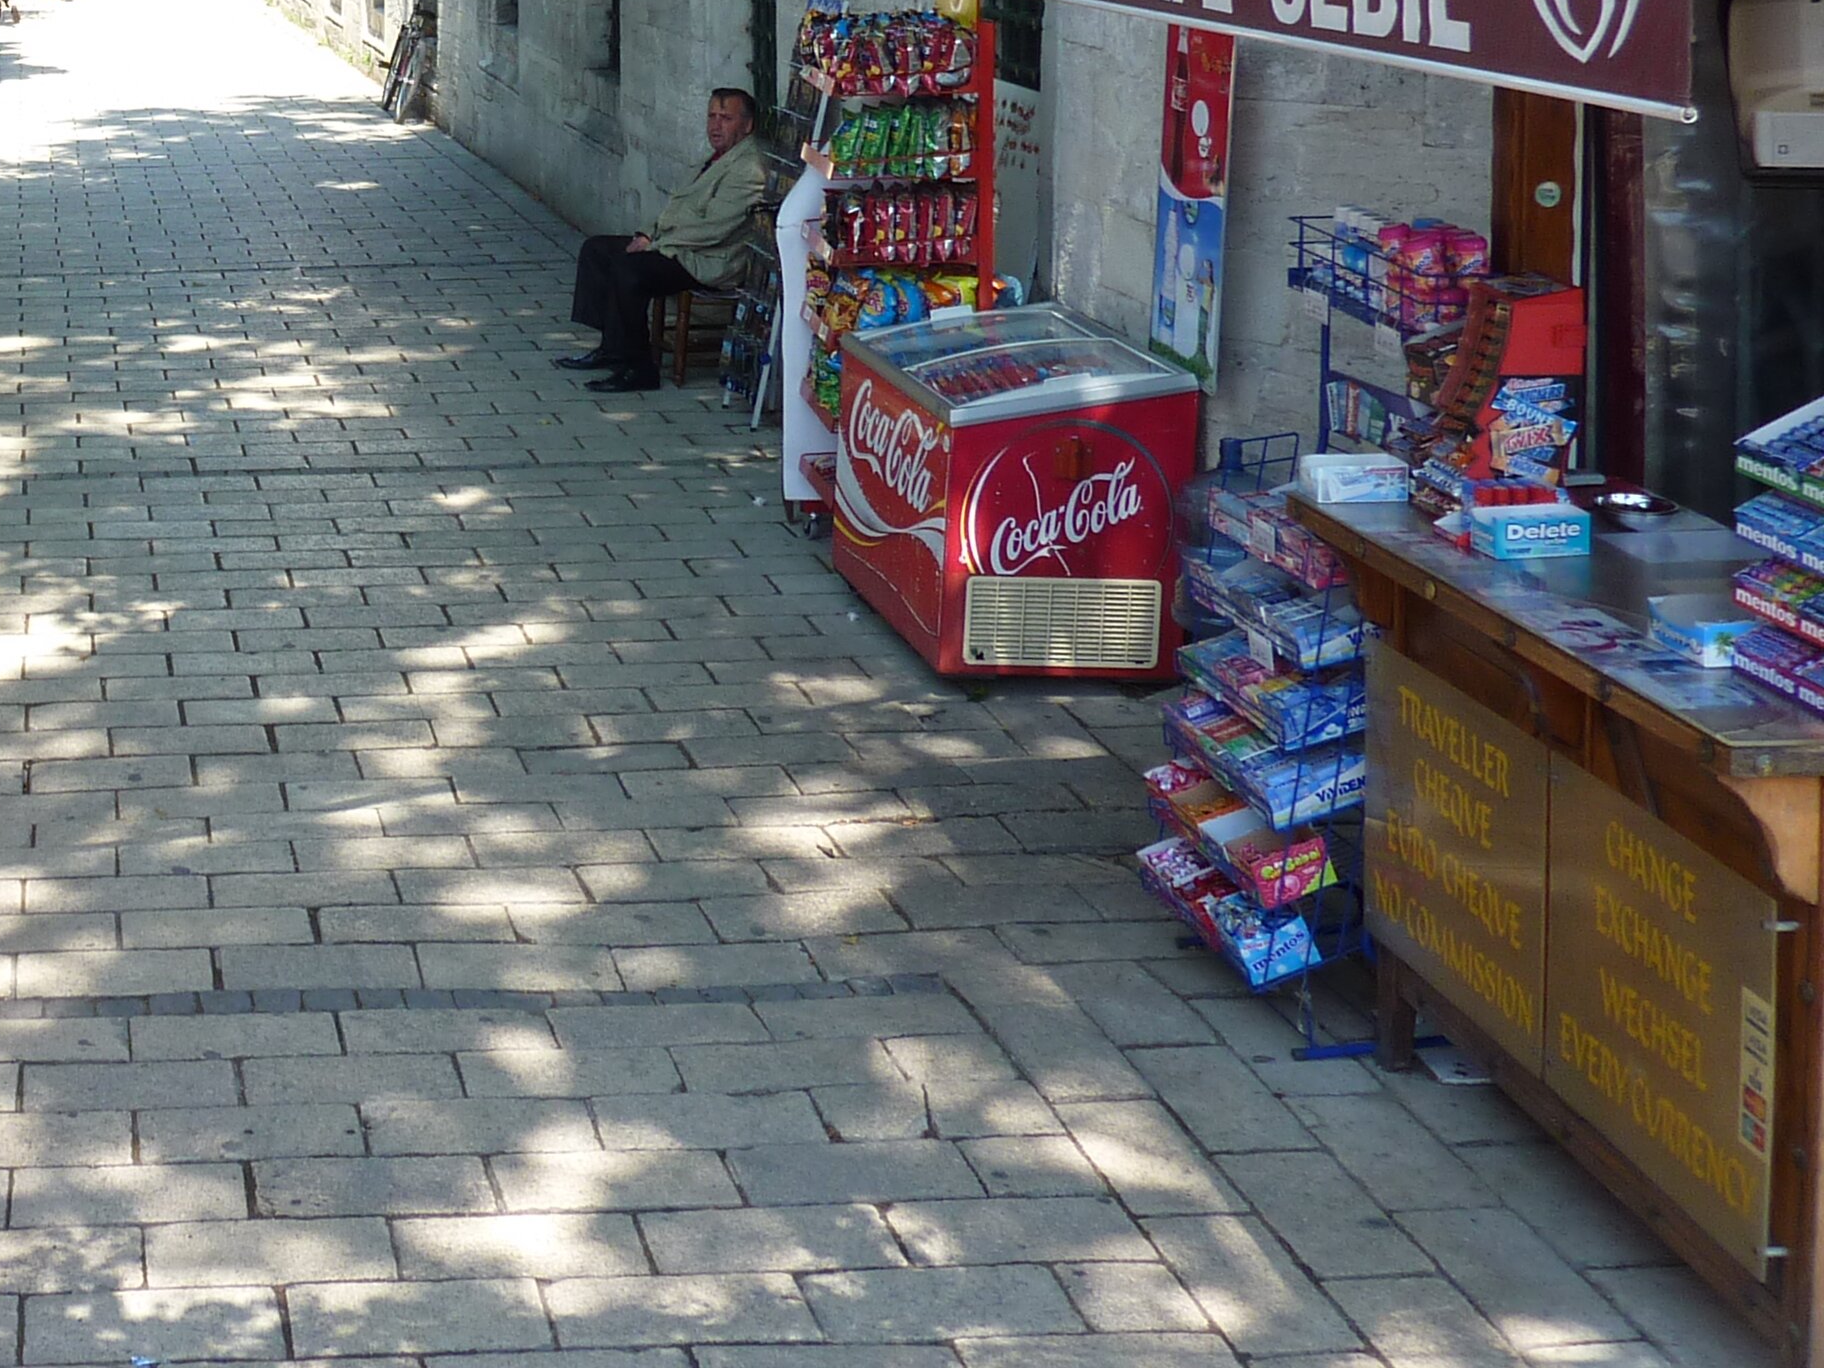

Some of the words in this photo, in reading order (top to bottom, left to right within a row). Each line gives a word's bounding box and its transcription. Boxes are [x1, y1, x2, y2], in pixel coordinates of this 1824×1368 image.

[990, 456, 1142, 576] Coca-Cola
[1737, 455, 1799, 491] mentos
[1505, 521, 1582, 541] Delete
[1736, 521, 1797, 560] mentos
[1736, 587, 1797, 628] mentos
[1734, 652, 1795, 694] mentos
[1397, 685, 1511, 799] TRAVELLER
[1386, 808, 1438, 880] EURO
[1605, 820, 1697, 924] CHANGE
[1252, 931, 1305, 971] mentos
[1374, 868, 1402, 923] NO
[1406, 897, 1535, 1034] COMMISSION
[1595, 884, 1714, 1016] EXCHANGE
[1599, 966, 1708, 1092] WECHSEL
[1560, 1011, 1626, 1105] EVERY
[1631, 1077, 1756, 1219] CURRENCY
